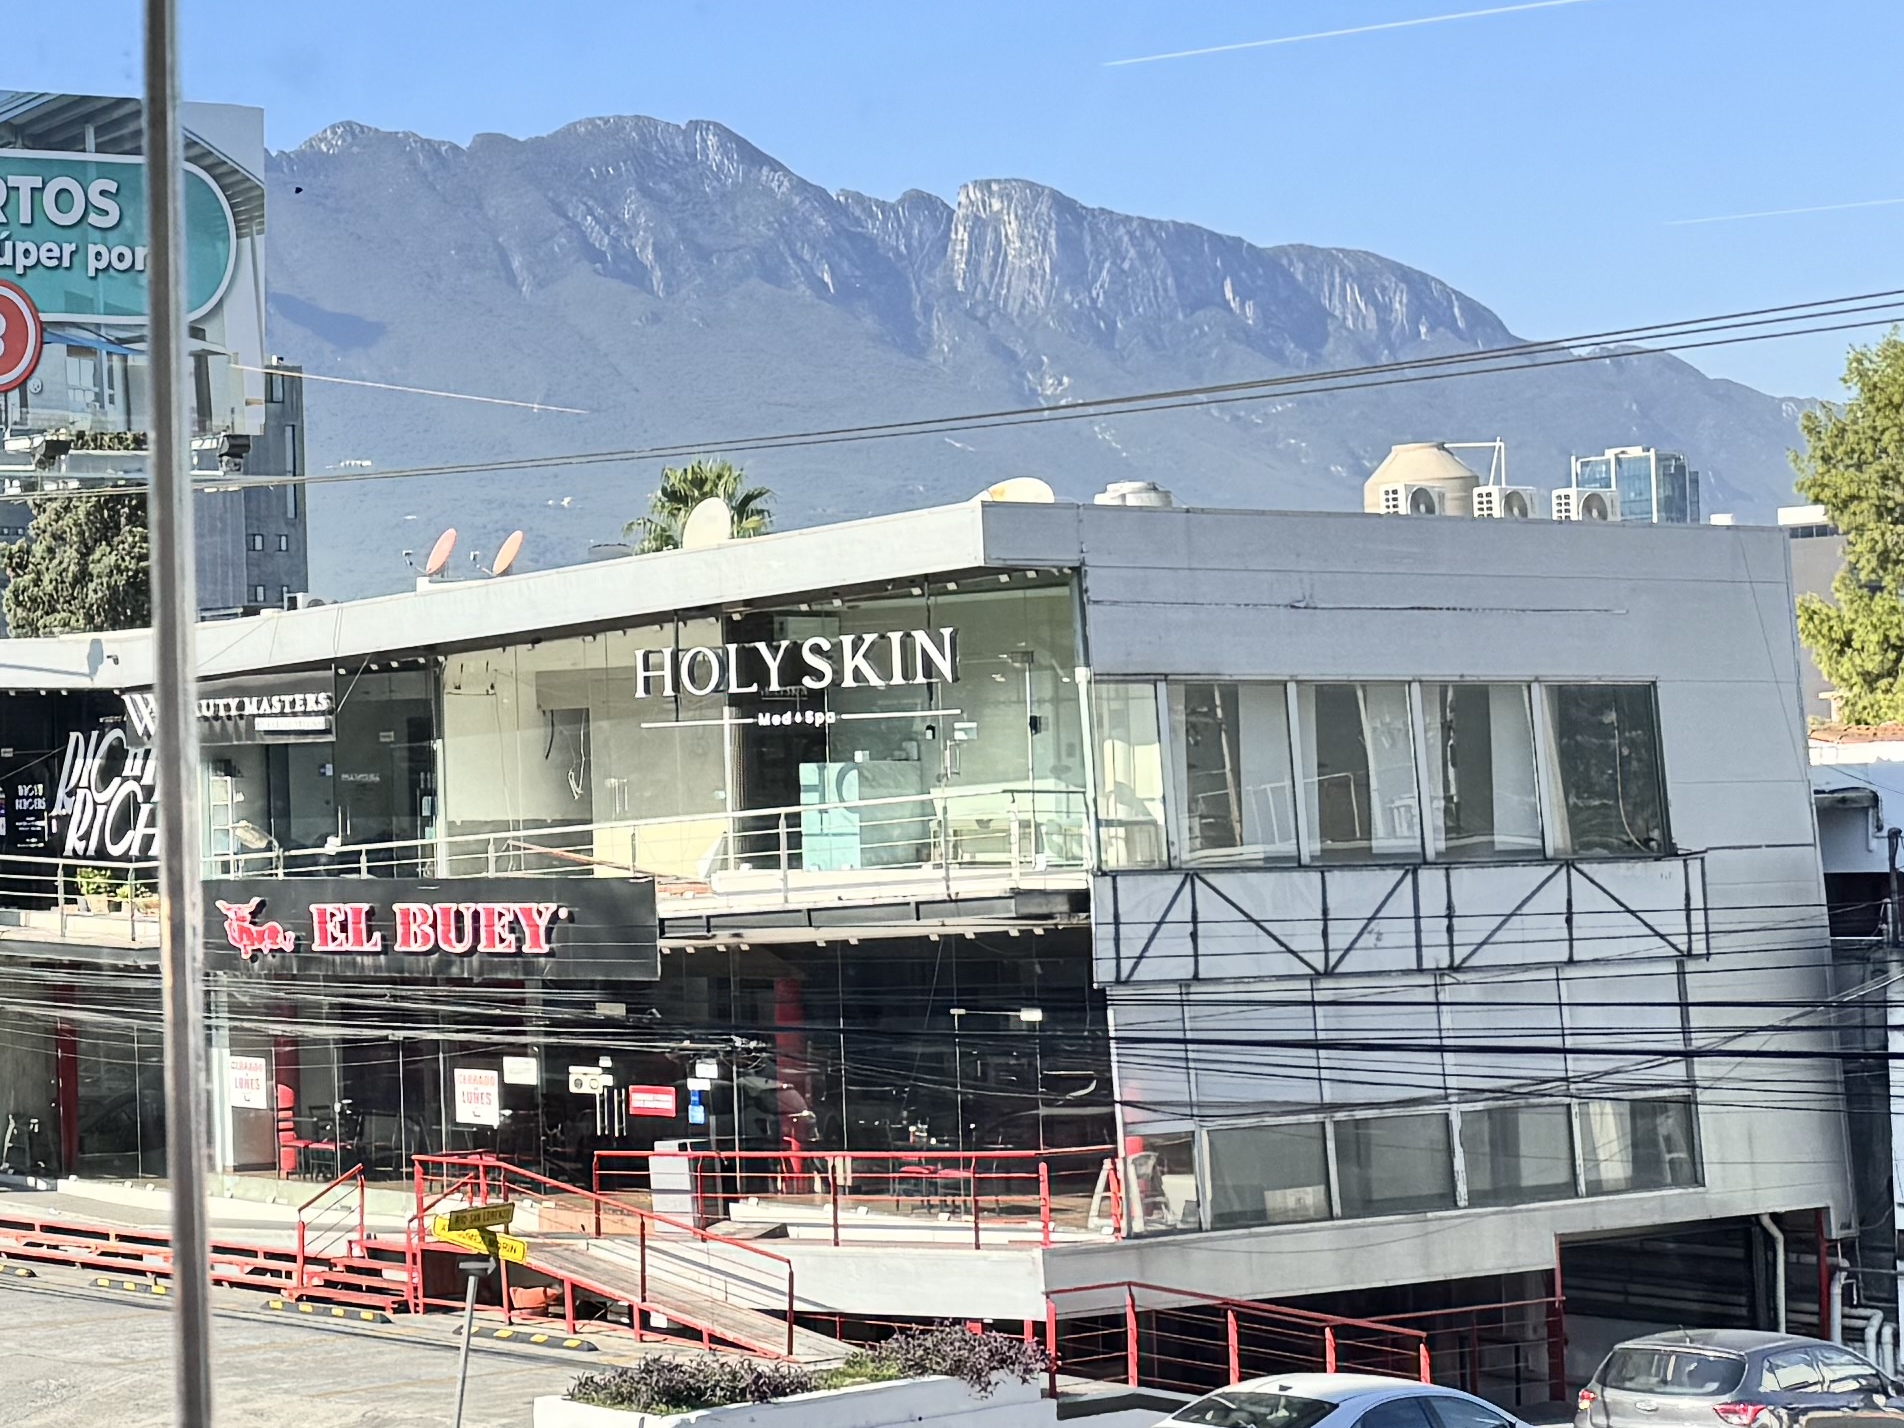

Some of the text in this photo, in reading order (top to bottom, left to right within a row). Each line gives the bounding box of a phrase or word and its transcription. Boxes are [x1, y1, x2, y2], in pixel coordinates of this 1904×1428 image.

[87, 242, 148, 277] por
[243, 692, 330, 715] MASTERS
[309, 903, 557, 953] EL BUEY
[462, 1090, 492, 1106] LUNES
